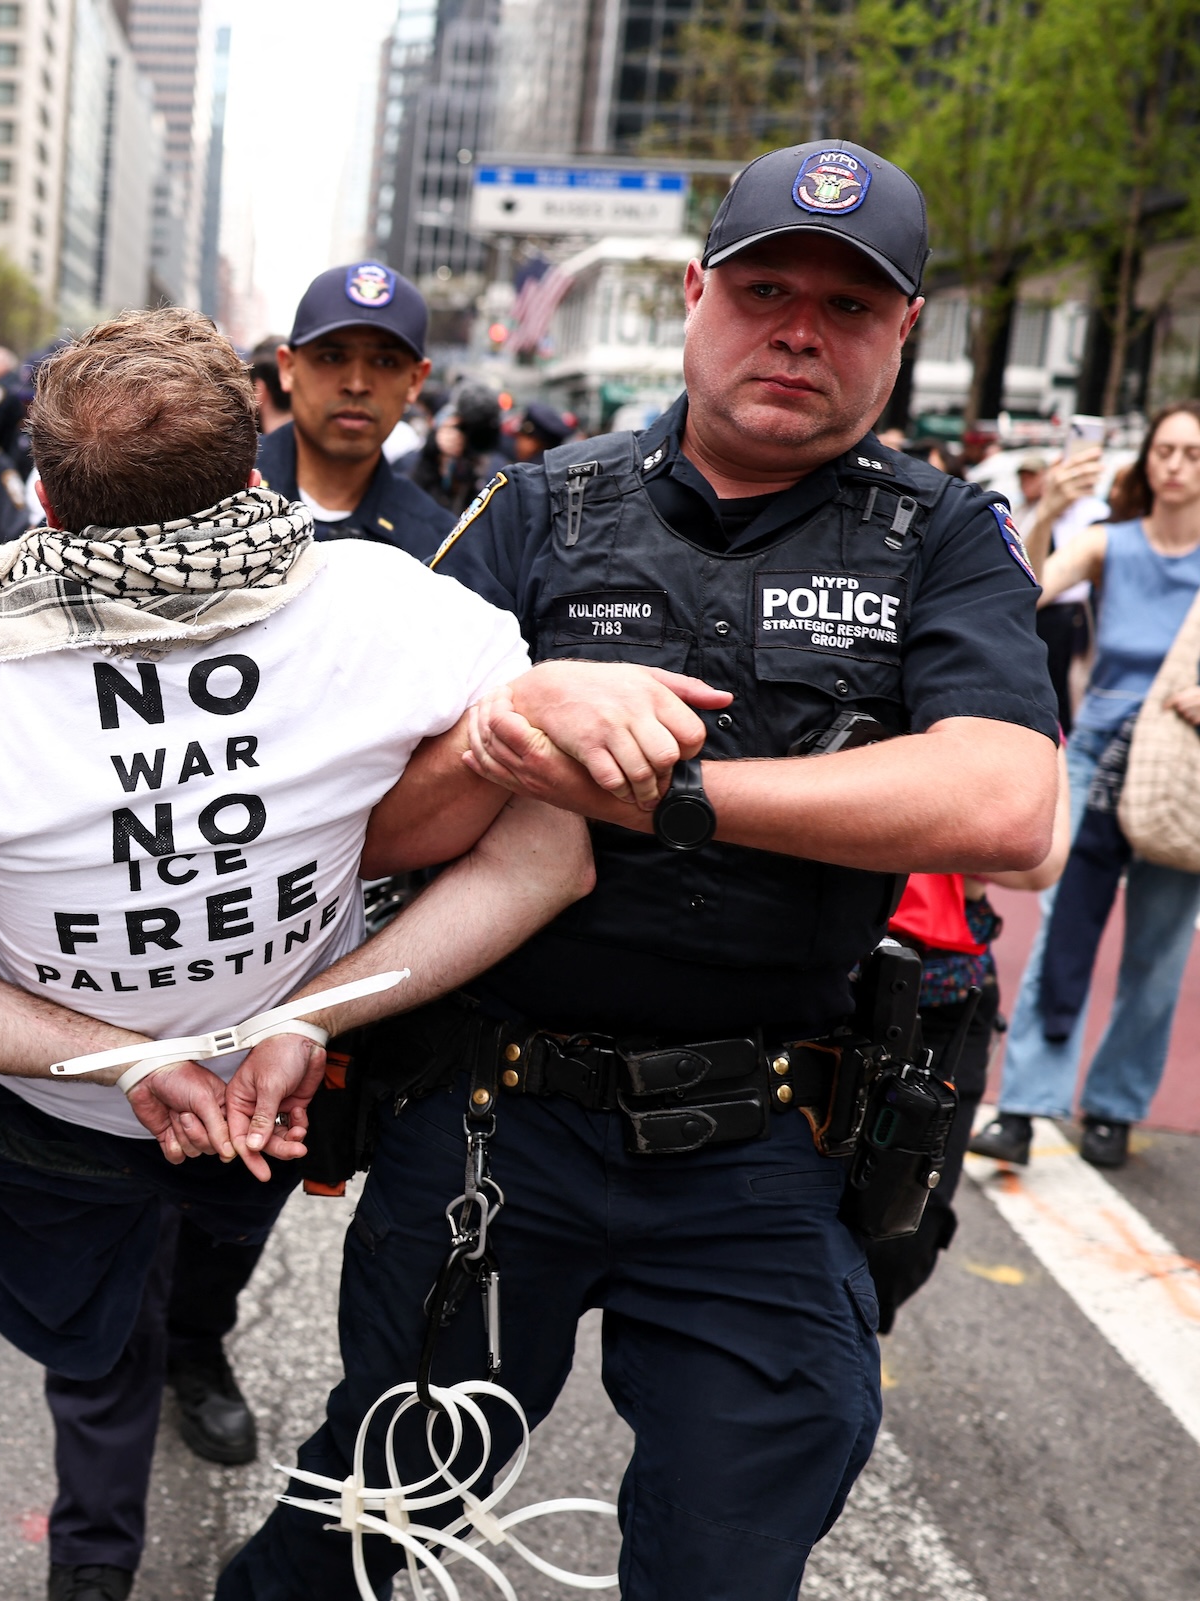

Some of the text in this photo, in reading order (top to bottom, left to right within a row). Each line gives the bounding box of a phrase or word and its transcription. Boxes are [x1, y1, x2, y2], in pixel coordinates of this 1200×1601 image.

[819, 153, 858, 170] NYPD
[643, 449, 662, 470] S3
[857, 456, 883, 470] S3
[811, 575, 859, 590] NYPD
[568, 603, 652, 618] KULICHENKO
[762, 587, 900, 630] POLICE
[591, 621, 622, 636] 7183
[762, 619, 898, 643] STRATEGIC RESPONSE
[810, 633, 855, 649] GROUP
[93, 654, 260, 730] NO
[110, 735, 260, 792] WAR
[112, 793, 267, 864] NO
[128, 848, 248, 891] ICE
[54, 860, 318, 956] FREE
[34, 895, 340, 992] PALESTINE
